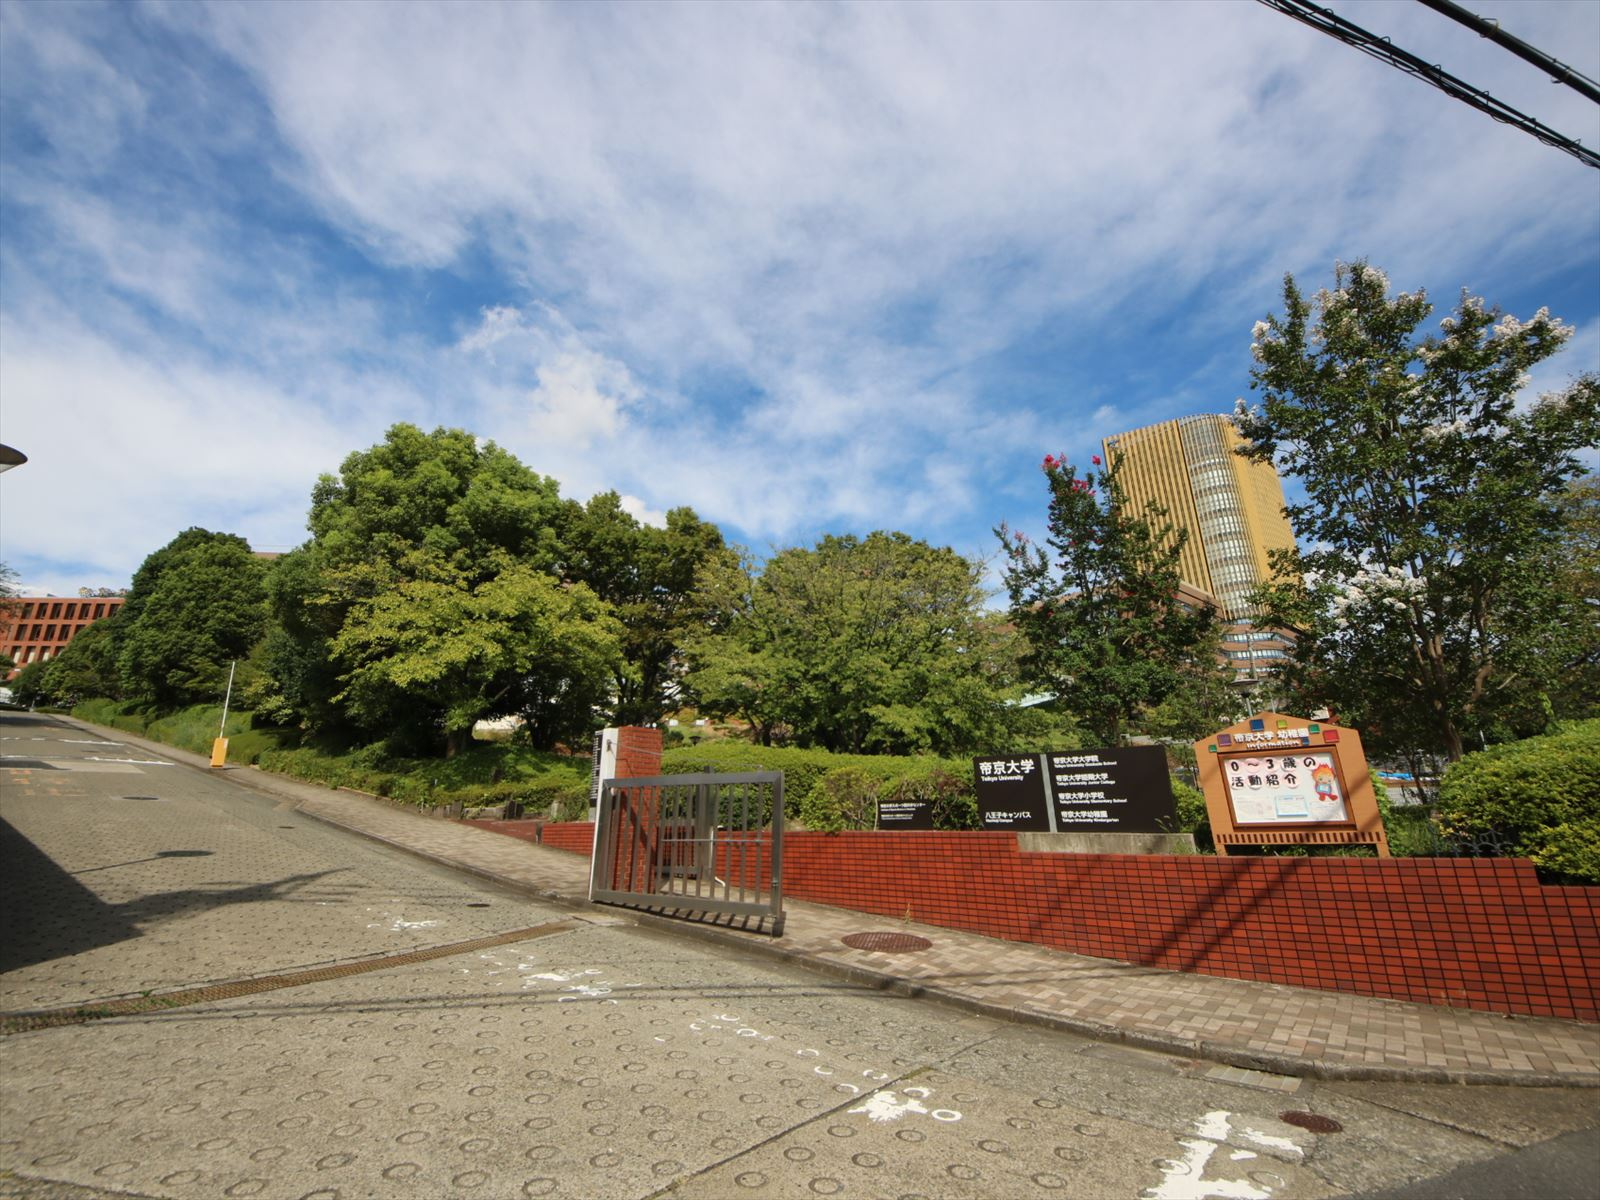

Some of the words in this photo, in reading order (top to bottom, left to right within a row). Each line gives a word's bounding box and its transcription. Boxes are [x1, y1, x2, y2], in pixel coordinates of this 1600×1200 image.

[979, 758, 1035, 775] 帝京大学
[1231, 773, 1297, 788] 活動紹介
